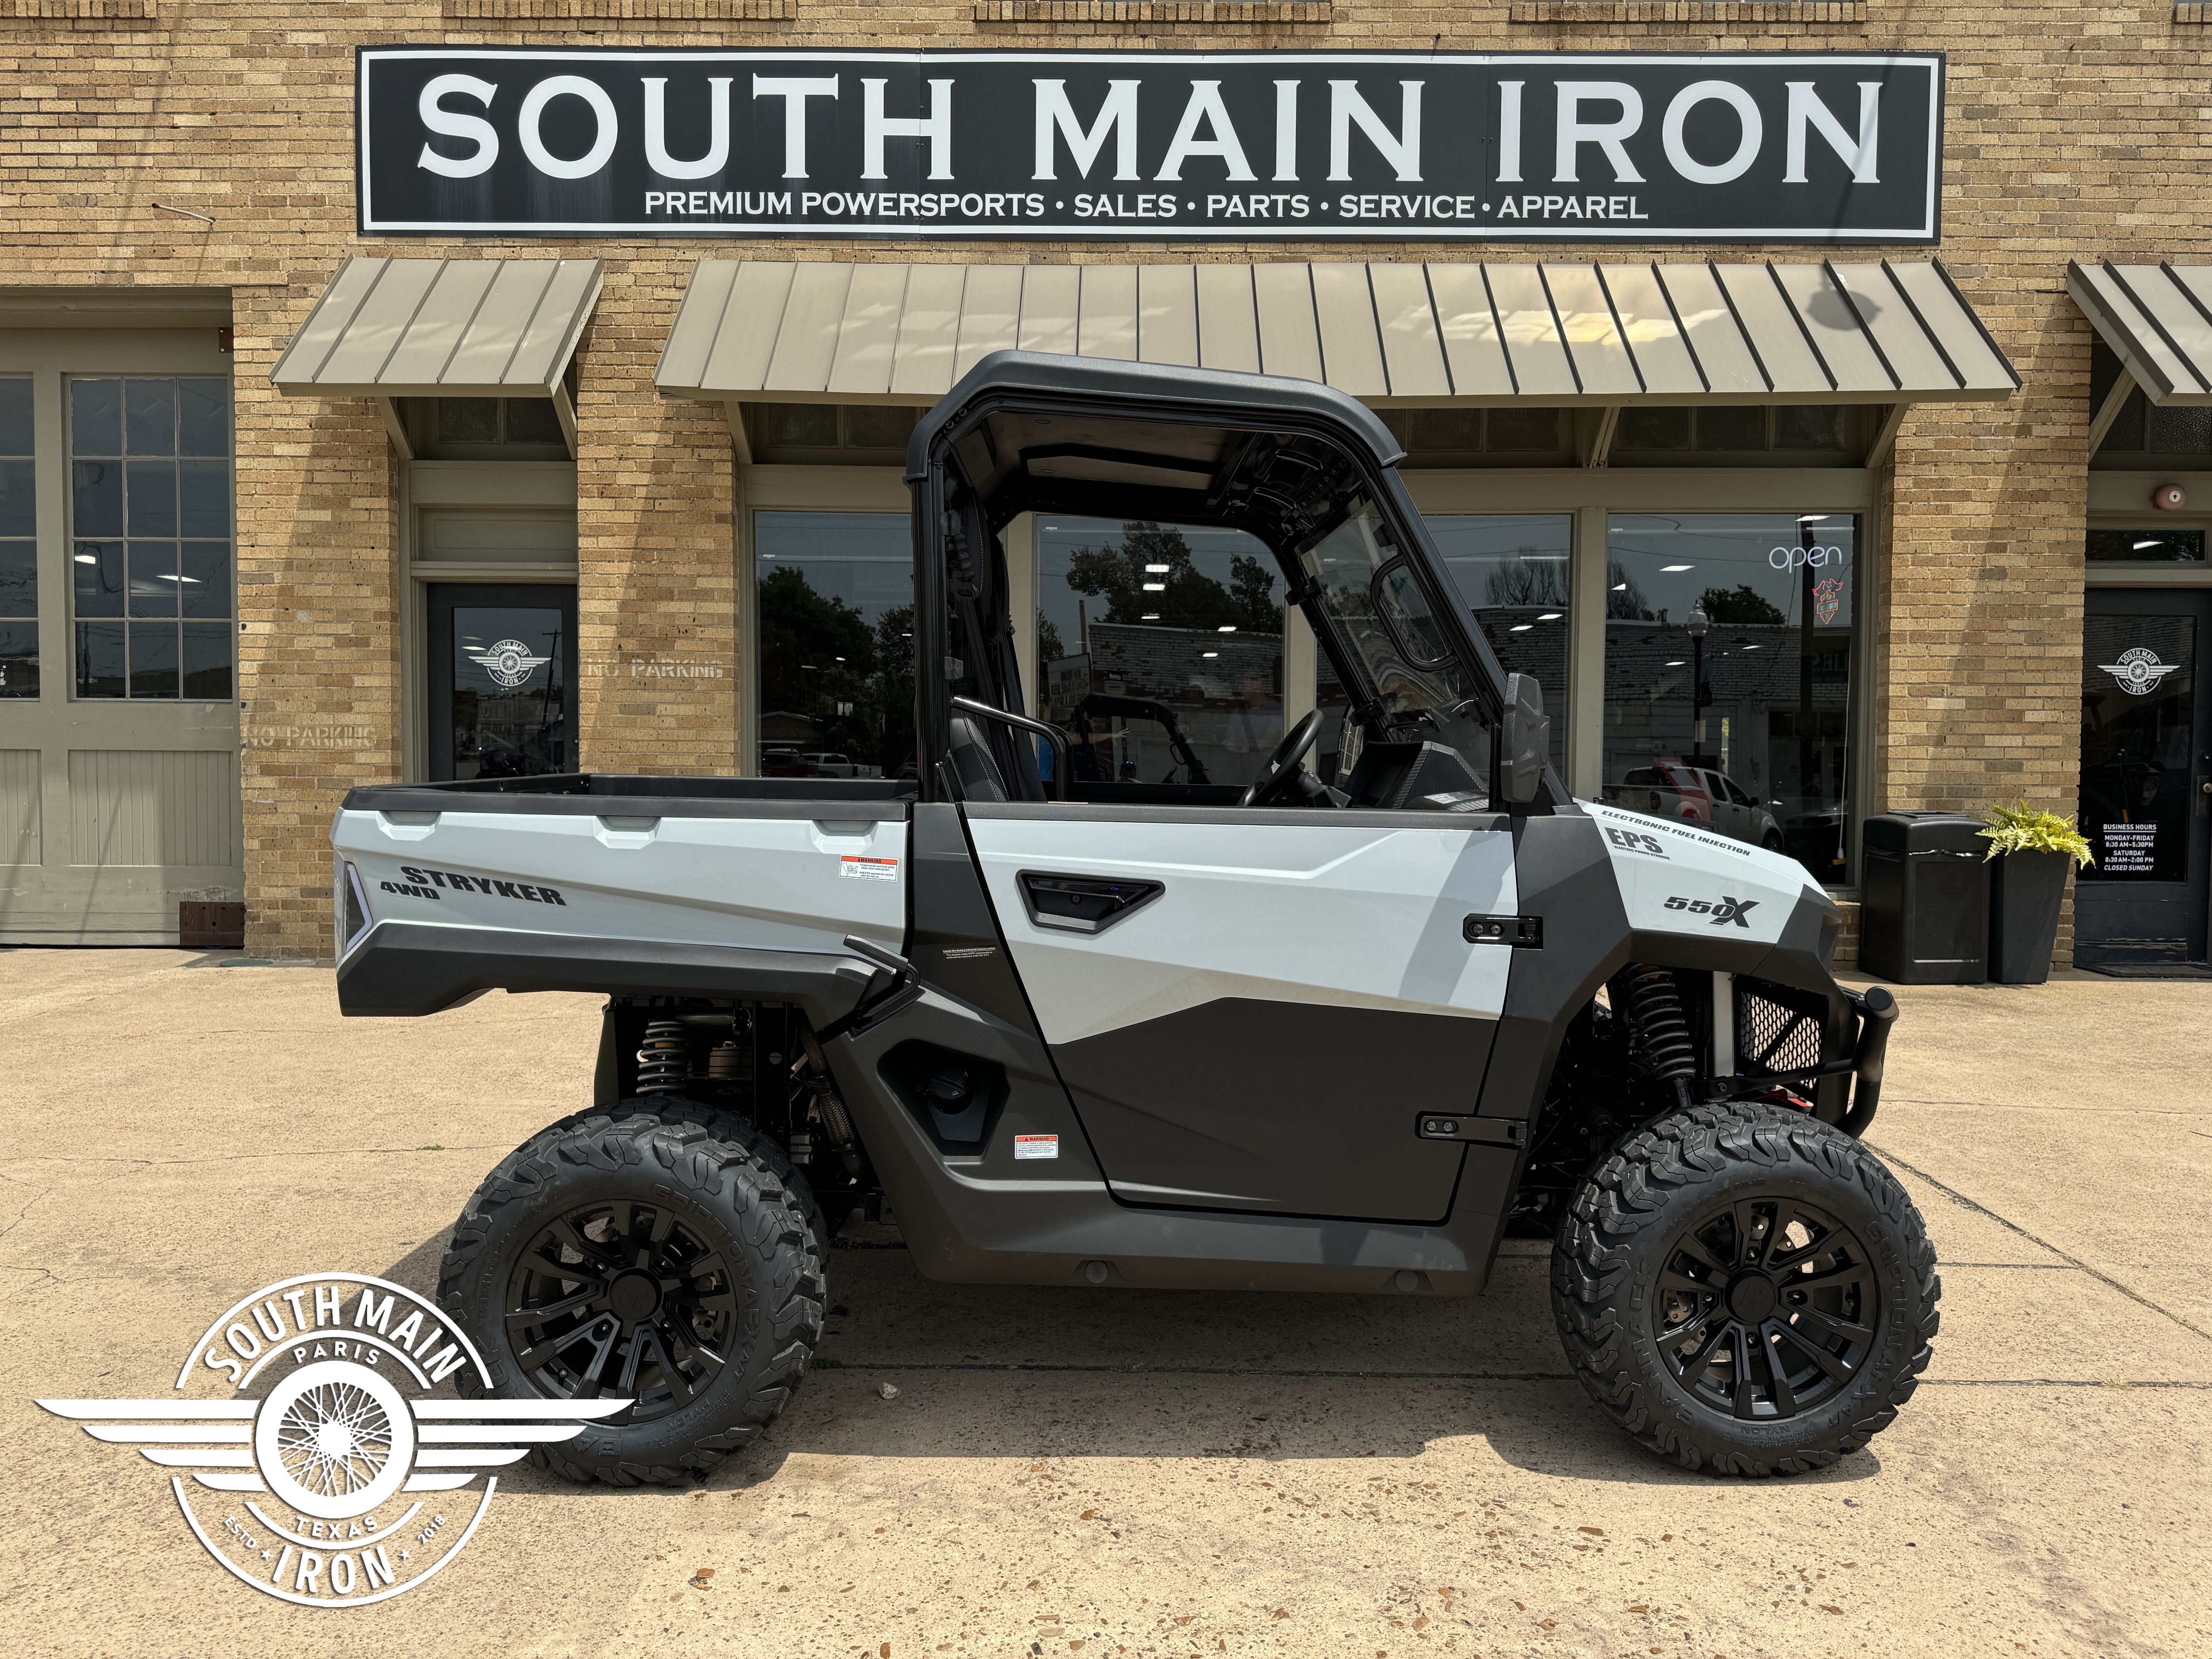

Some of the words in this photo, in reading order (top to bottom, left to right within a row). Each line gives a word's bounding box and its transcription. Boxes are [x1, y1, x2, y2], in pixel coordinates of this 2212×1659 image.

[417, 73, 955, 181] SOUTH
[1032, 79, 1425, 182] MAIN
[1496, 80, 1884, 185] IRON
[645, 191, 792, 216] PREMIUM
[802, 192, 1045, 218] POWERSPORTS
[1074, 194, 1176, 218] SALES
[1206, 194, 1310, 219] PARTS
[1338, 195, 1475, 220] SERVICE
[1497, 196, 1649, 220] APPAREL
[1769, 546, 1842, 574] open
[492, 641, 511, 655] SOUTH
[2121, 650, 2140, 664] SOUTH
[2142, 650, 2157, 664] MAIN
[632, 658, 723, 678] PARKING
[242, 726, 275, 747] NO
[287, 726, 376, 747] PARKING
[1601, 810, 1670, 832] ELECTRONIC
[1671, 828, 1695, 840] FUEL
[1698, 836, 1750, 856] INJECTION
[1604, 827, 1663, 854] EPS
[380, 881, 440, 900] 4WD
[400, 866, 567, 906] STRYKER
[1663, 895, 1760, 928] 550X
[651, 1184, 753, 1281] GRIPTION
[1865, 1220, 1908, 1350] GRIPTION
[666, 1397, 710, 1432] NYLON
[1740, 1424, 1791, 1435] NYLON
